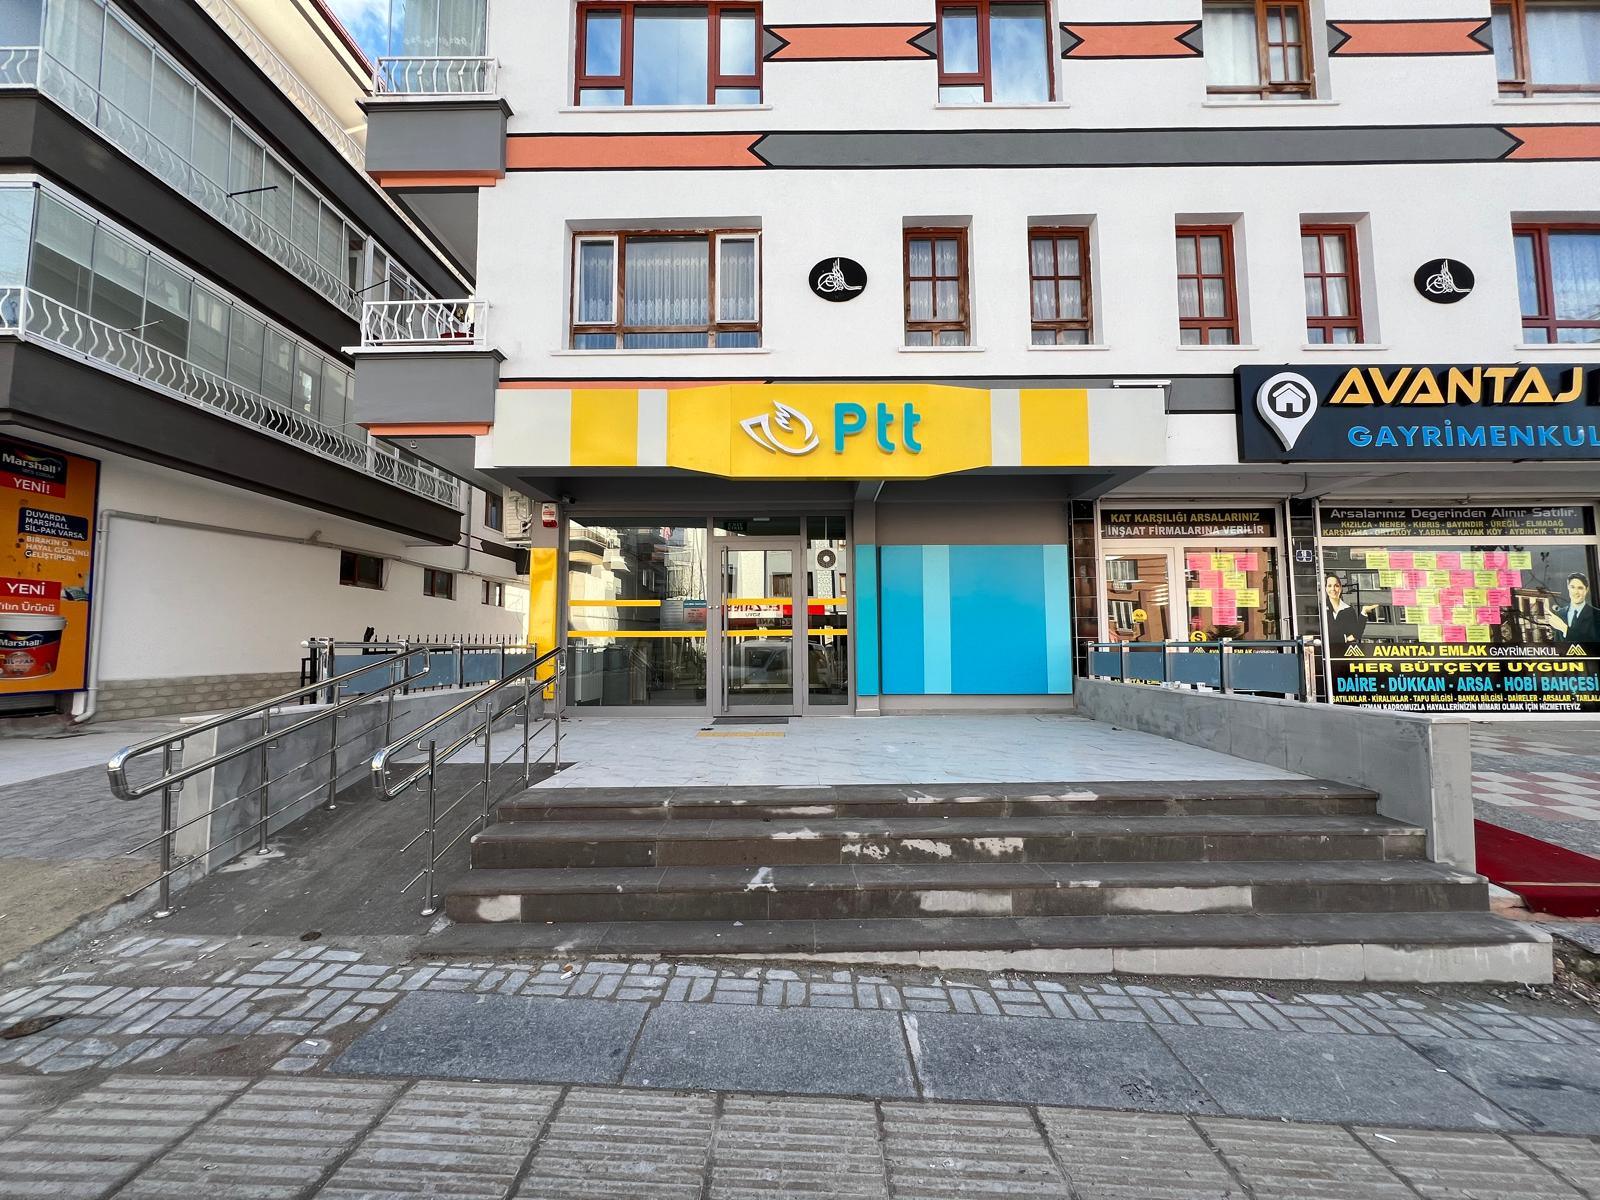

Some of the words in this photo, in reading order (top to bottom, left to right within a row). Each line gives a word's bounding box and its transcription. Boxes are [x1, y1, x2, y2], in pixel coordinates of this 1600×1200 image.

[1329, 367, 1583, 404] AVANTAJ
[834, 402, 922, 454] Ptt
[1348, 420, 1600, 447] GAYRİMENKUL
[2, 453, 57, 473] Marshall
[13, 477, 50, 494] YENİ!
[26, 510, 67, 522] DUVARDA
[1110, 514, 1132, 522] KAT
[1134, 512, 1187, 524] KARŞILIĞI
[1190, 512, 1260, 522] ARSALARINIZ
[1330, 508, 1406, 518] Arsalarınız
[1411, 508, 1486, 520] Degerinden
[1492, 508, 1527, 518] Alınır
[1532, 508, 1577, 518] Satılır.
[25, 518, 70, 530] MARSHALL
[1526, 519, 1564, 527] ELMADAĞ
[24, 524, 56, 535] SİL-PAK
[1108, 524, 1146, 536] İNŞAAT
[1149, 524, 1220, 536] FİRMALARINA
[1224, 524, 1264, 534] VERİLİR
[26, 543, 53, 552] HAYAL
[6, 582, 46, 595] YENİ
[22, 601, 55, 612] Ürünü
[1373, 646, 1436, 656] AVANTAJ
[1439, 646, 1488, 656] EMLAK
[1489, 646, 1560, 656] GAYRİMENKUL
[1350, 663, 1394, 672] HER
[1400, 660, 1500, 674] BÜTÇEYE
[1508, 662, 1584, 672] UYGUN
[1337, 674, 1377, 692] DAİRE
[1389, 674, 1445, 692] DÜKKAN
[1457, 676, 1493, 691] ARSA
[1504, 674, 1537, 691] HOBİ
[1541, 673, 1599, 694] BAHÇESİ
[1372, 694, 1408, 702] KİRALIKLAR
[1431, 694, 1453, 702] BİLGİSİ
[1481, 694, 1503, 702] BİLGİSİ
[1508, 693, 1538, 702] DAİRELER
[1426, 702, 1476, 711] HAYALLERİNİZİN
[1525, 702, 1538, 712] İÇİN
[1540, 702, 1581, 710] HİZMETTEYİZ
